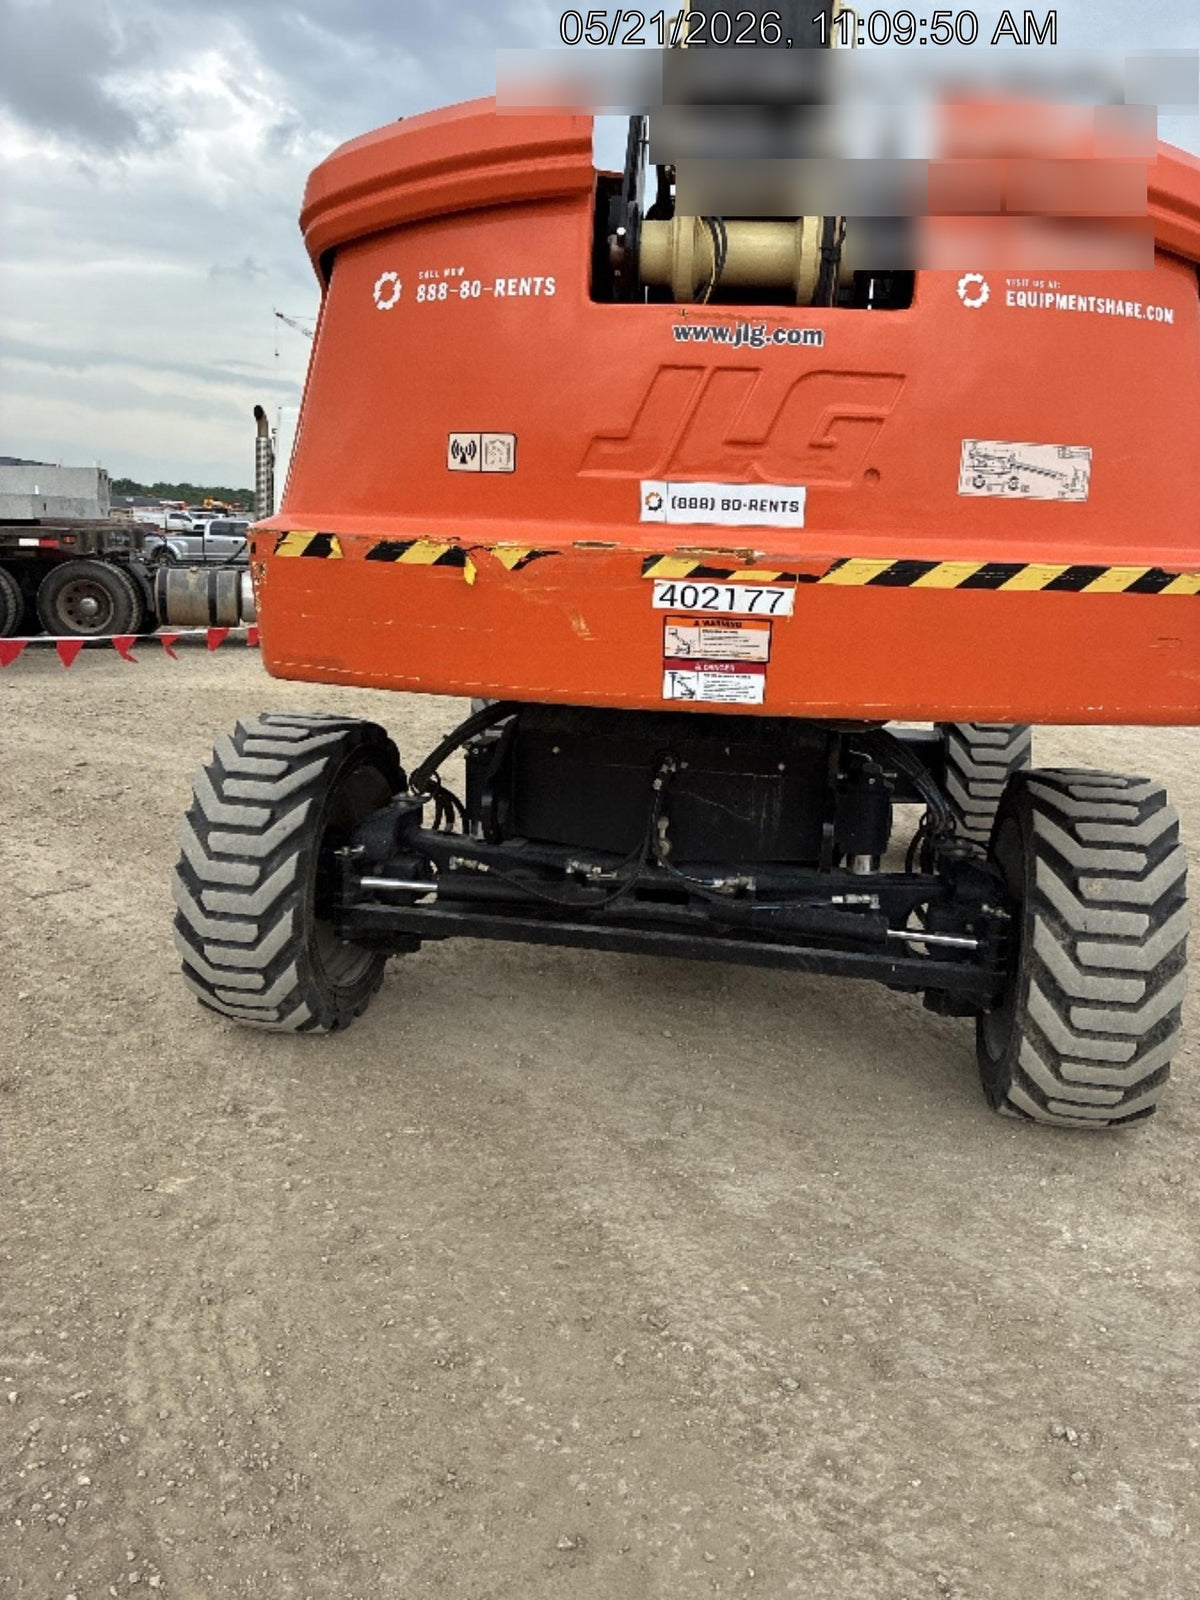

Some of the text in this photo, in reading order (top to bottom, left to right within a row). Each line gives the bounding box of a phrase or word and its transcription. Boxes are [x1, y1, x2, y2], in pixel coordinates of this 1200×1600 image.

[416, 277, 556, 303] 888-80-RENTS
[672, 323, 824, 347] www.jlg.com
[577, 363, 906, 488] JLG
[671, 495, 800, 513] (888) 80-RENTS
[658, 584, 785, 614] 402177
